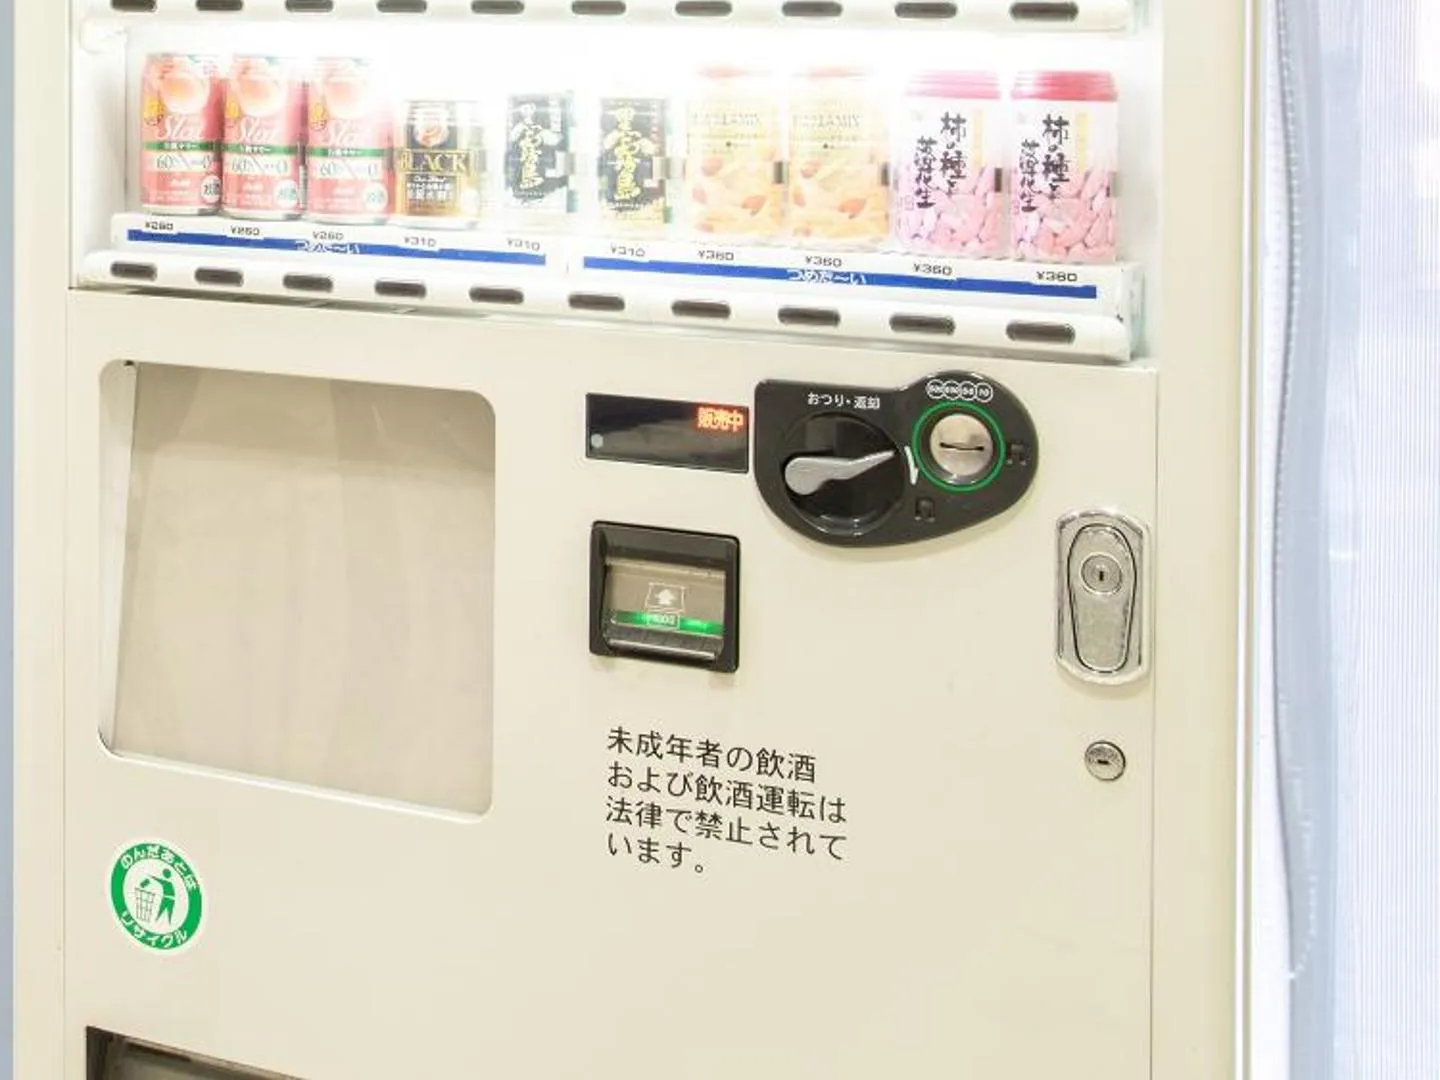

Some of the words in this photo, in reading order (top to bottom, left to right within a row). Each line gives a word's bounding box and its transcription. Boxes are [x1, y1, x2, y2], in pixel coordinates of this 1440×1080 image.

[698, 407, 744, 432] 販売中
[608, 726, 816, 784] 未成年者の飲酒
[607, 761, 847, 824] および飲酒運転は
[606, 796, 848, 861] 法律で禁止されて
[608, 832, 705, 874] います。
